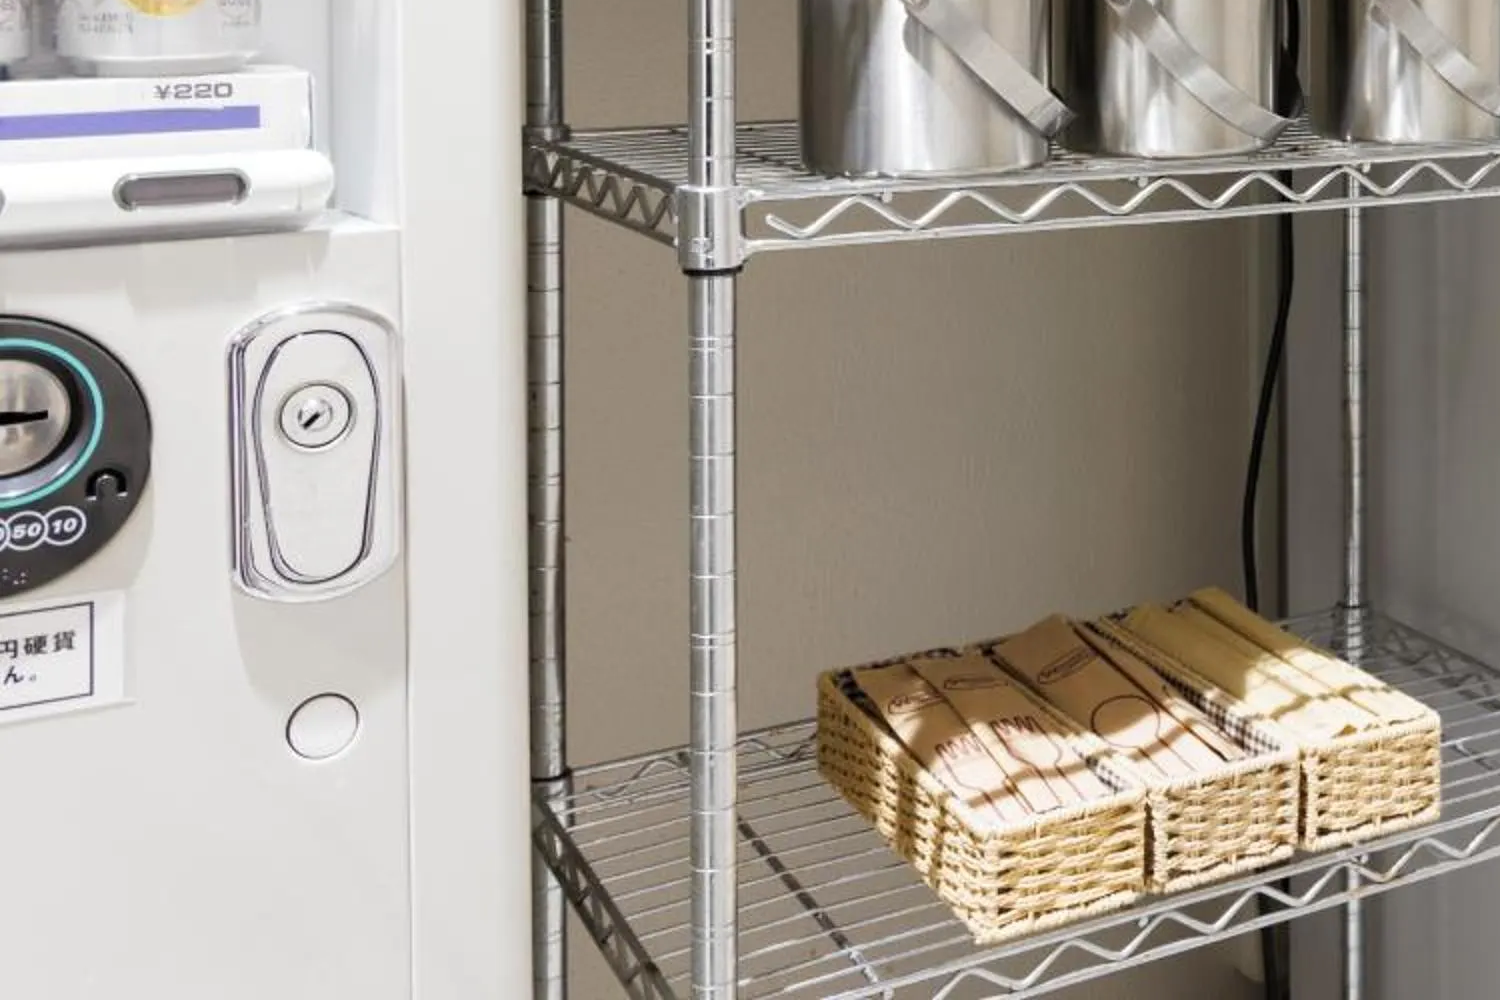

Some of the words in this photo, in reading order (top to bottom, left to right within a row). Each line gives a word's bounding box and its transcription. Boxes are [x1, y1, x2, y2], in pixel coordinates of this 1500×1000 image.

[153, 82, 234, 100] ¥220
[12, 523, 42, 539] 50
[51, 518, 78, 535] 10
[0, 630, 76, 659] 円硬貨
